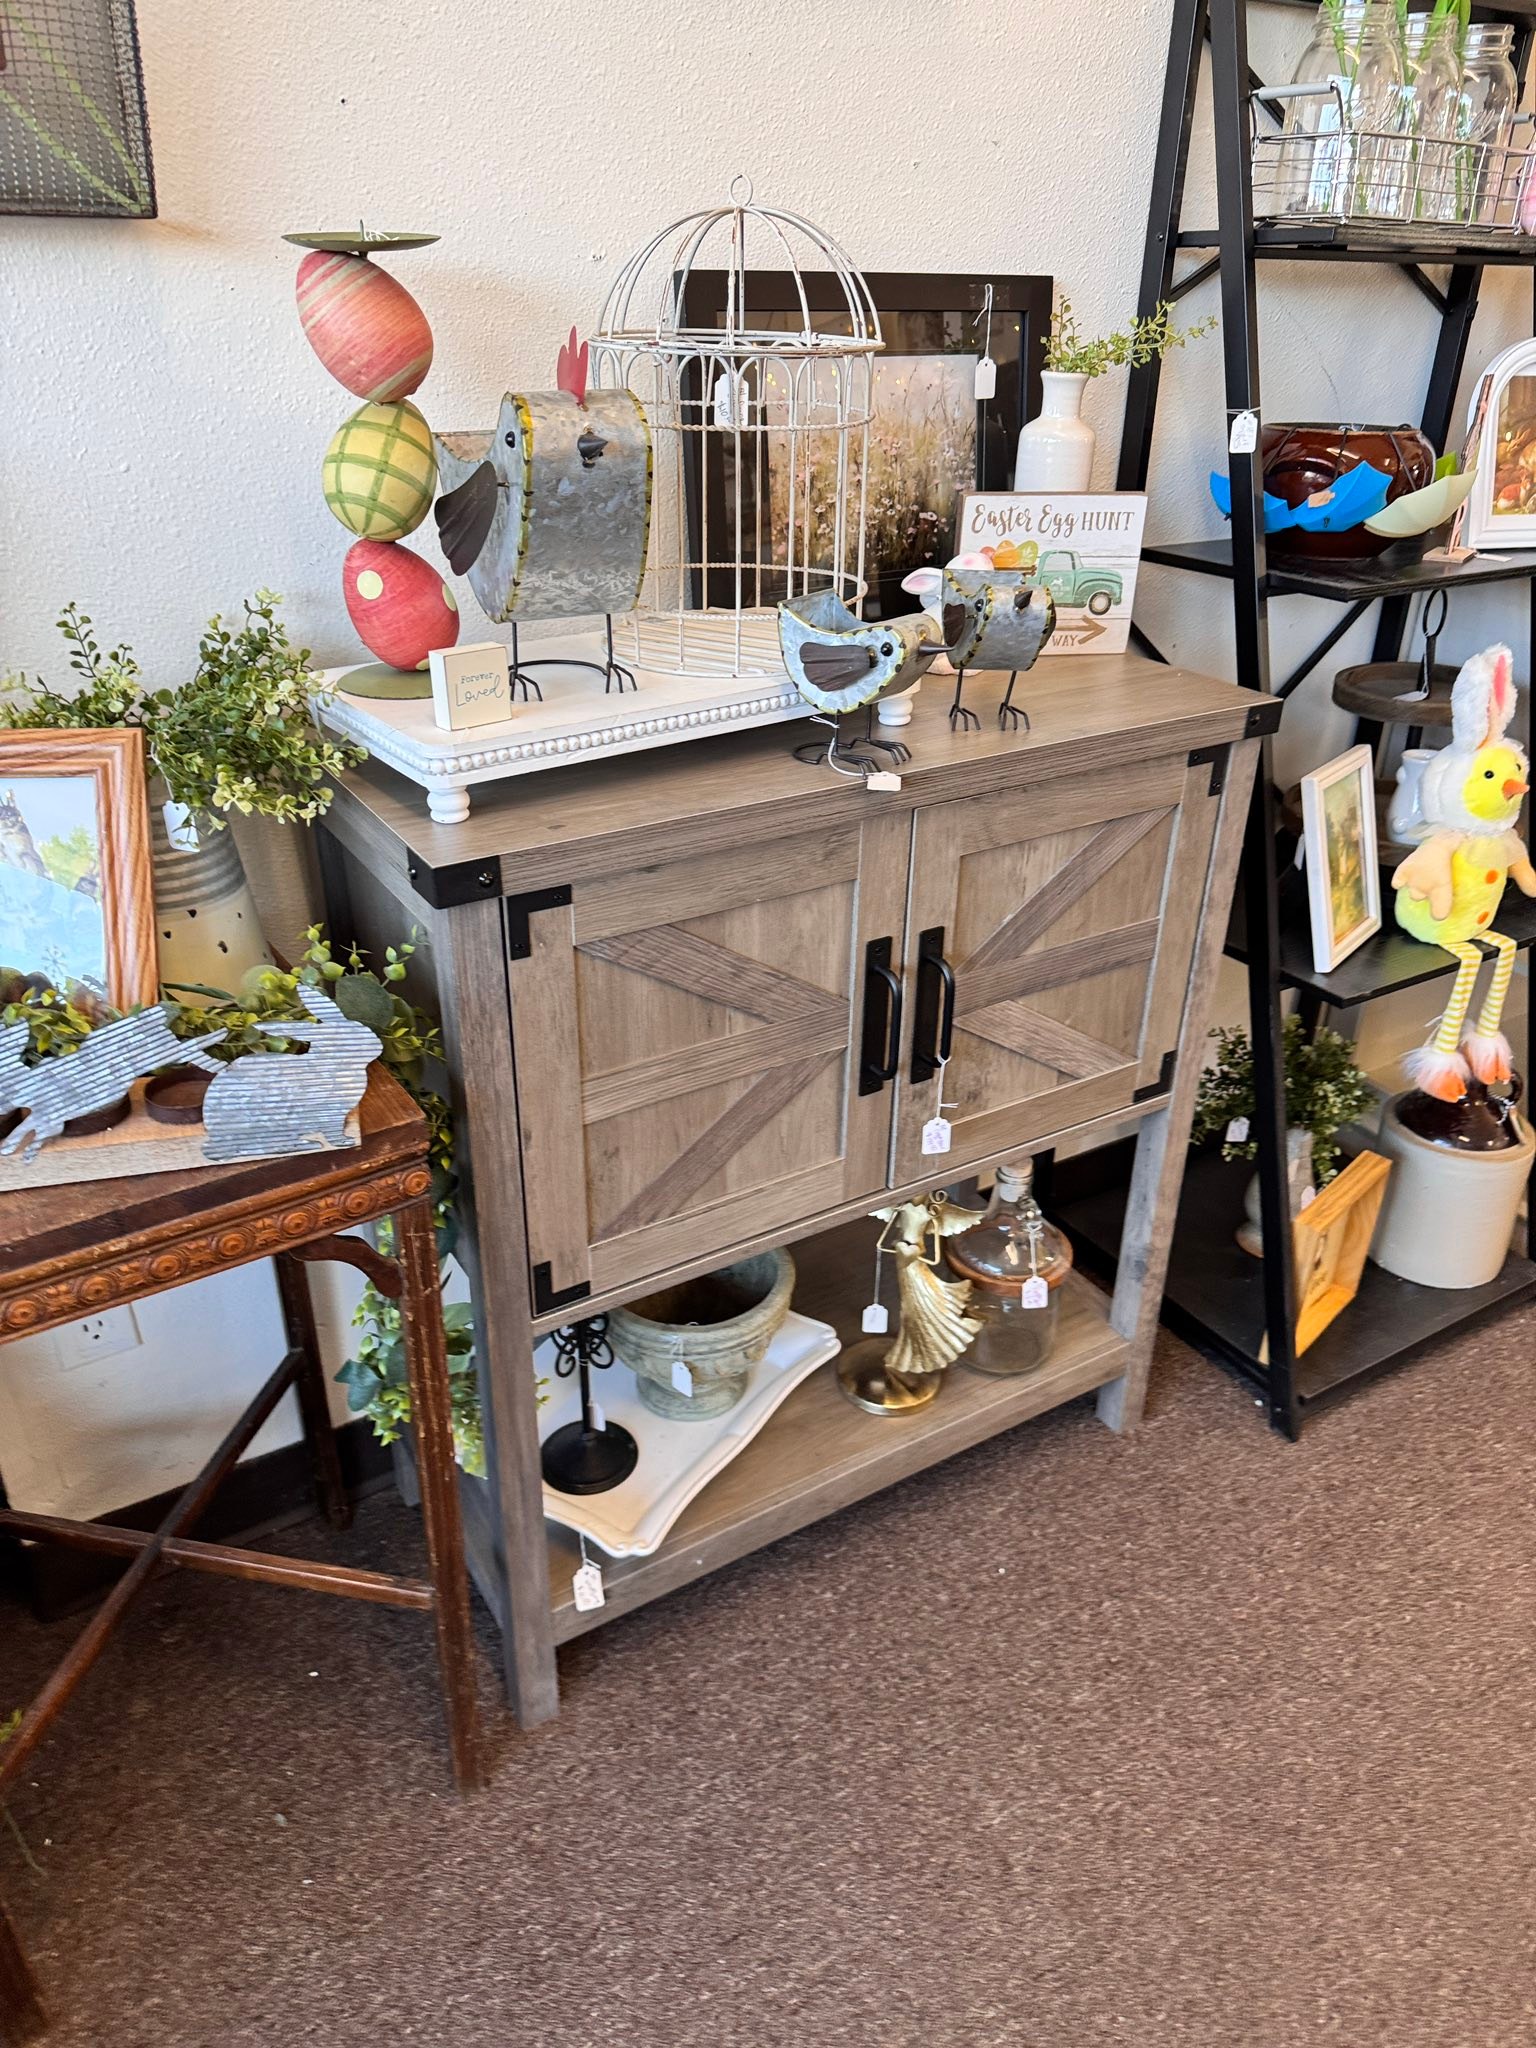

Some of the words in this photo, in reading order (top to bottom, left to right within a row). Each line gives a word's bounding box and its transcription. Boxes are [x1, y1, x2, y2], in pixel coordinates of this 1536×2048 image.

[971, 504, 1033, 537] Easter
[1038, 504, 1079, 537] Egg
[1081, 511, 1135, 531] HUNT
[1052, 634, 1079, 647] WAY
[460, 672, 494, 684] Forever
[455, 674, 505, 707] Loved
